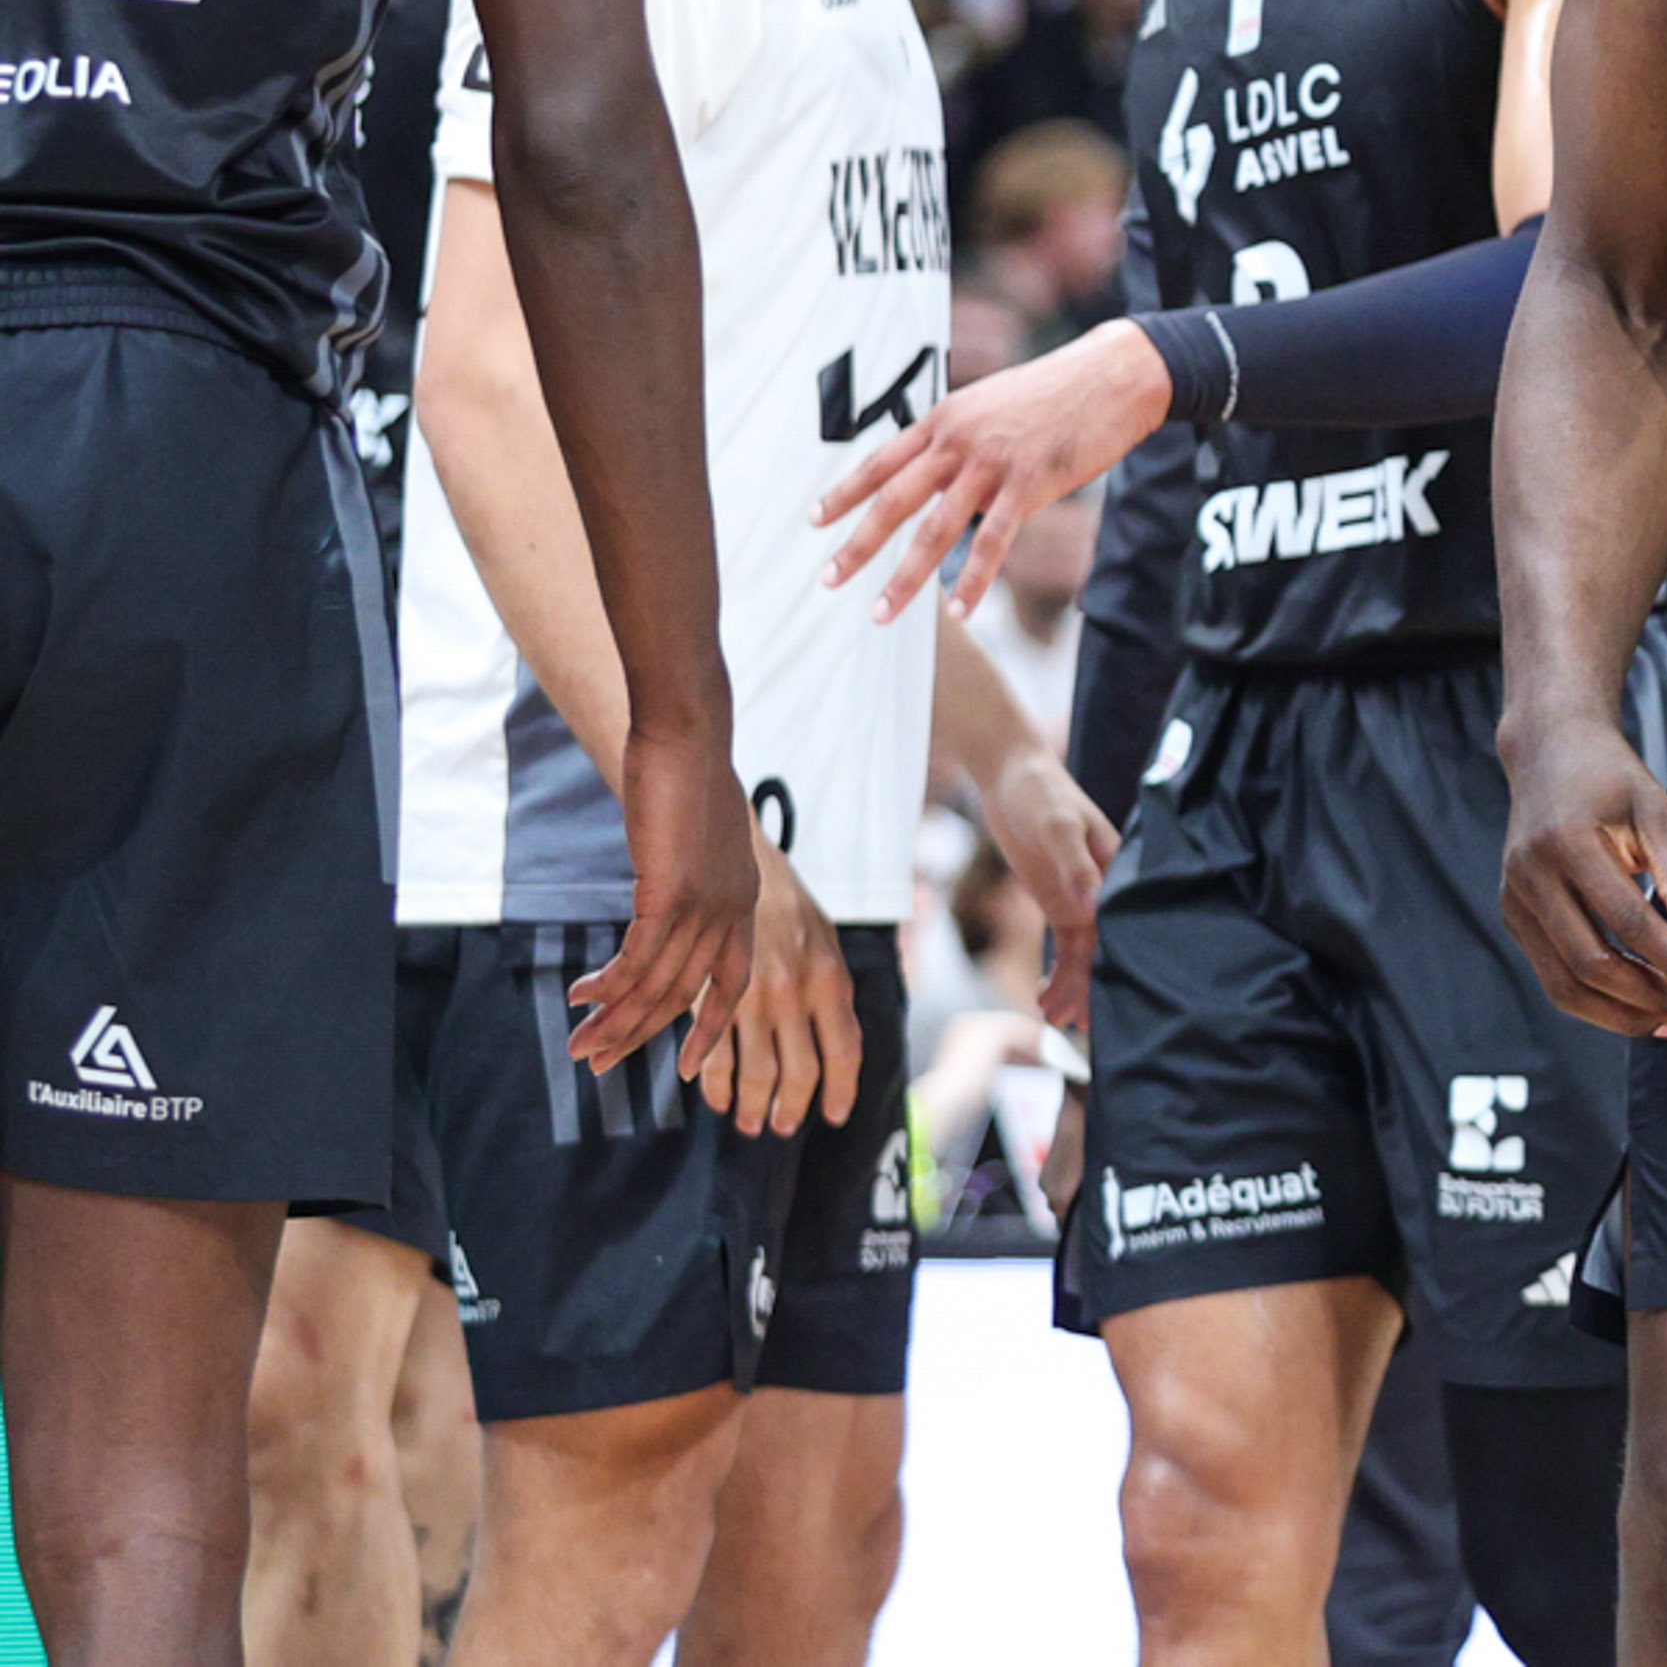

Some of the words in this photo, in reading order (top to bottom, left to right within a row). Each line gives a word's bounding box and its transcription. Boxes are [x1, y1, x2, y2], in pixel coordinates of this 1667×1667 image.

[1225, 63, 1340, 146] LDLC
[1233, 124, 1349, 191] ASVEL
[28, 1080, 148, 1118] l'Auxiliaire
[150, 1097, 203, 1120] BTP
[1155, 1162, 1322, 1220] Adéquat
